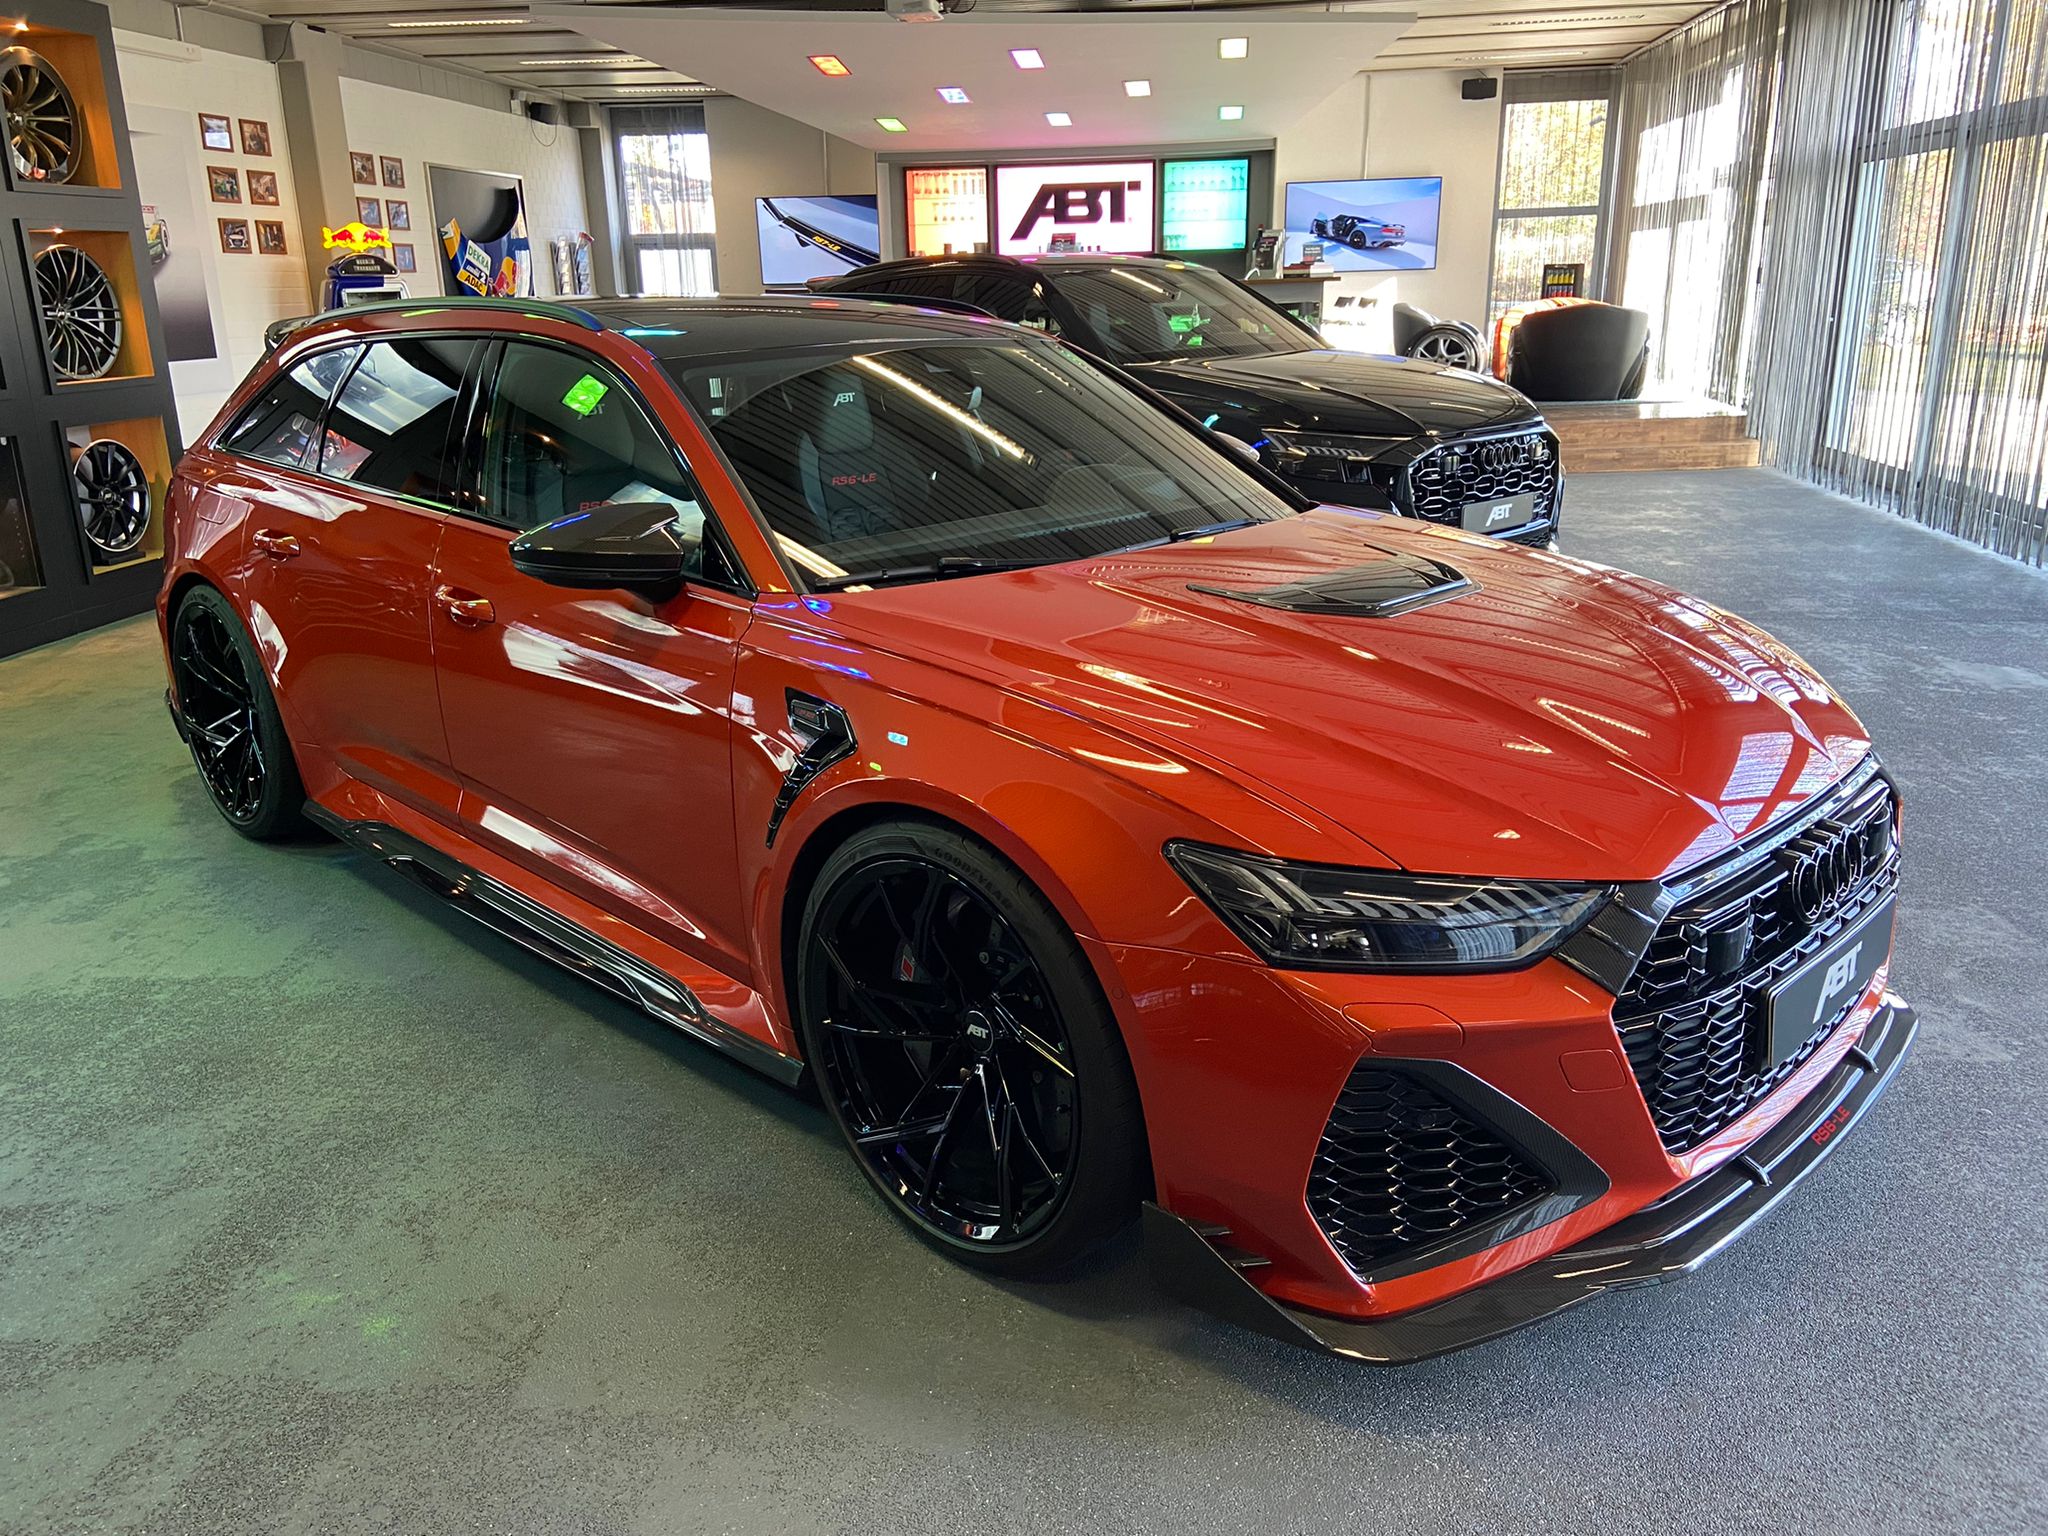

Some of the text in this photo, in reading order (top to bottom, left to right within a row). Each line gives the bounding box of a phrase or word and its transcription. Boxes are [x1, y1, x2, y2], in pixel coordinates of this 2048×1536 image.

[1010, 181, 1141, 240] ABT
[467, 245, 490, 271] DEKRA
[464, 274, 484, 292] ADAC
[833, 392, 855, 407] ABT
[832, 473, 877, 486] RS6-LE
[1485, 503, 1513, 527] ABT
[1812, 940, 1863, 1025] ABT
[966, 1023, 989, 1039] ABT
[1811, 1105, 1850, 1146] RS6-LE
